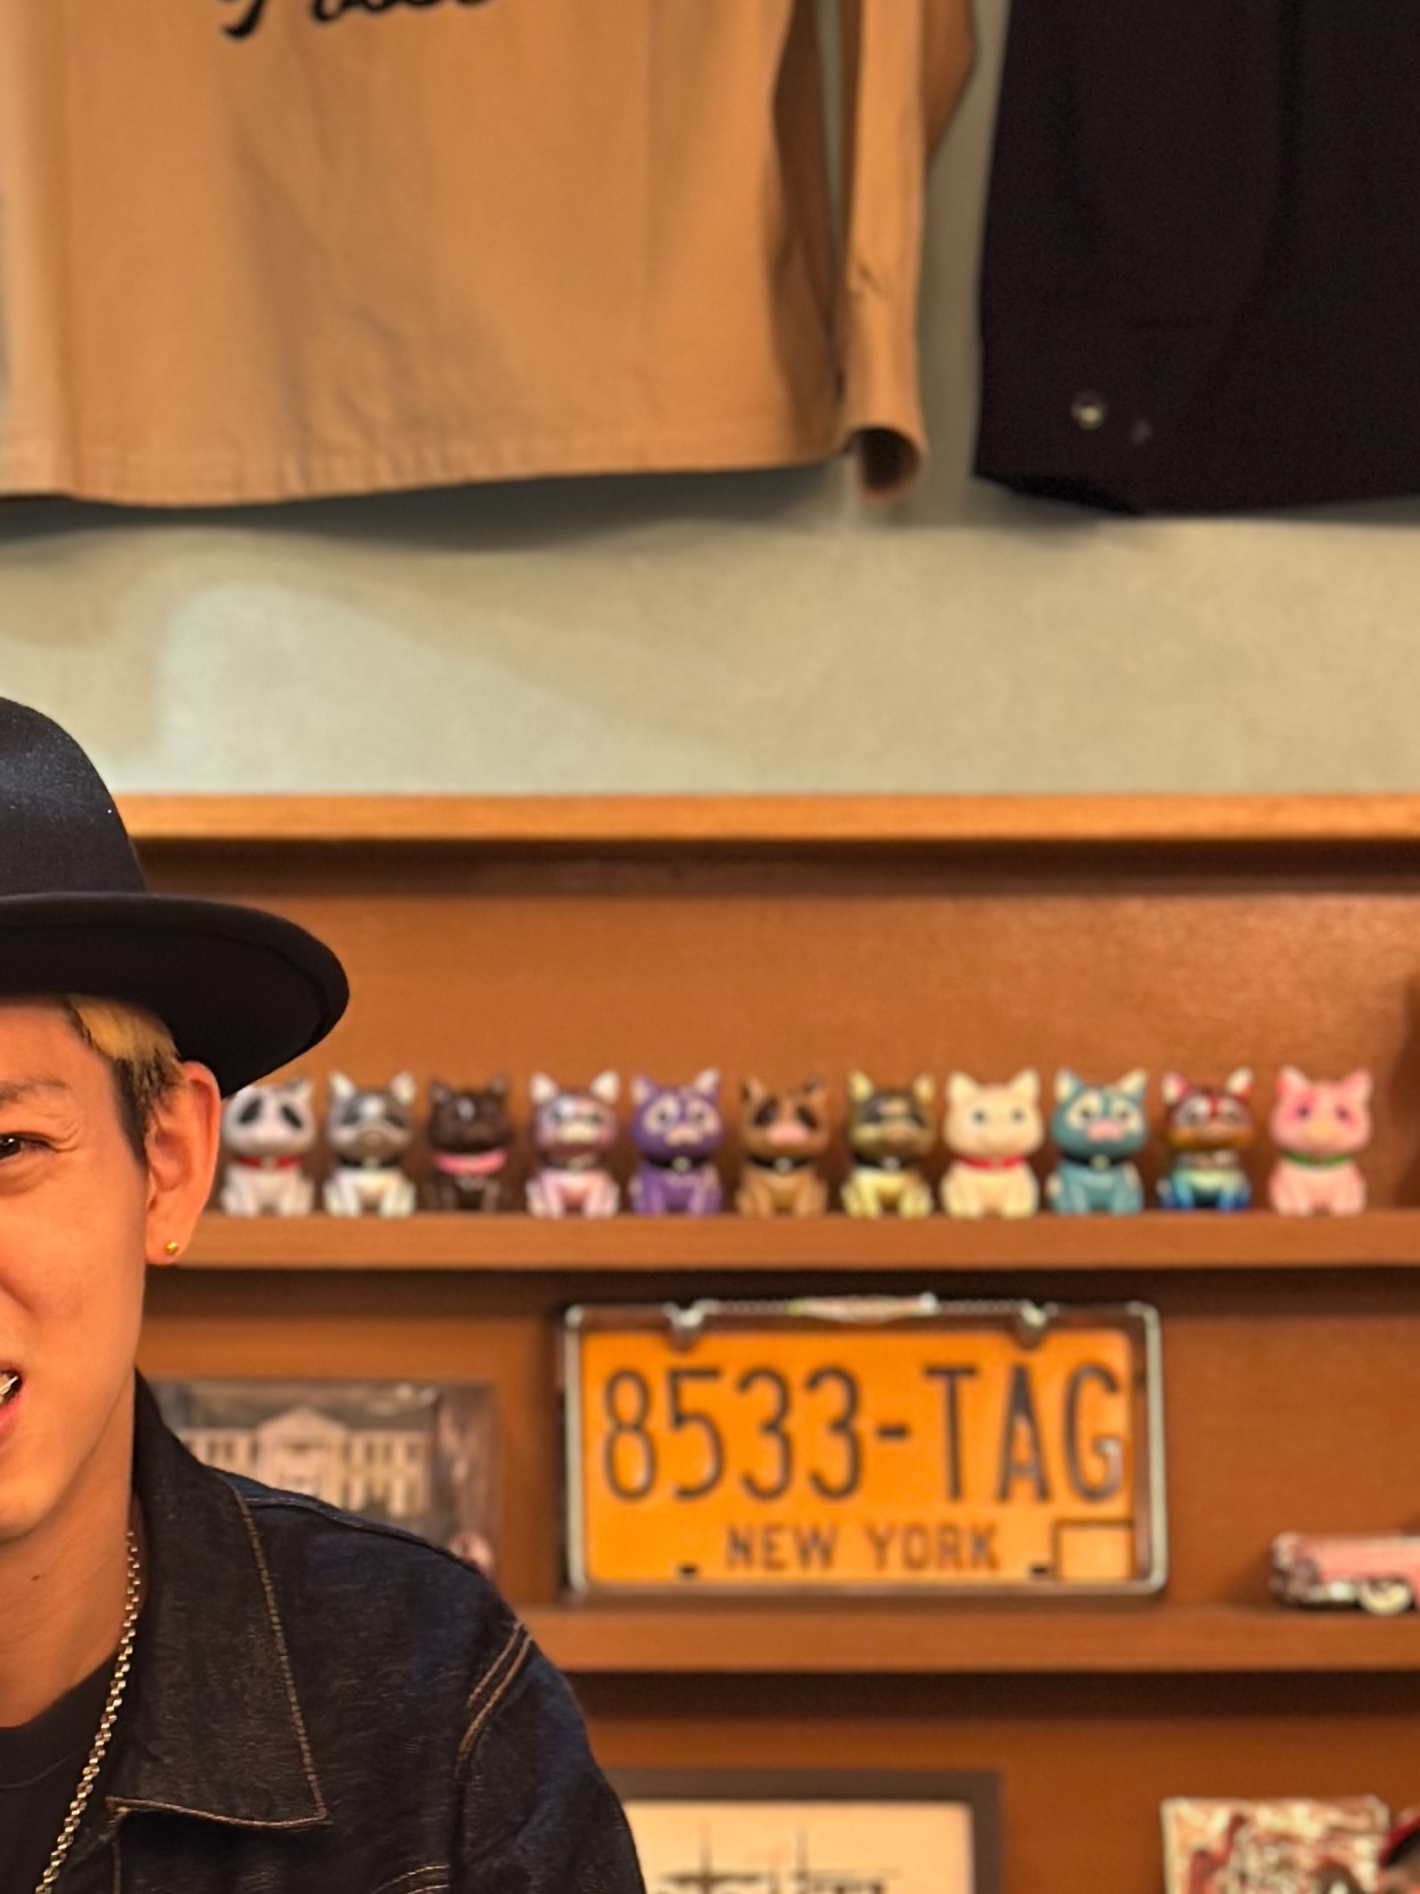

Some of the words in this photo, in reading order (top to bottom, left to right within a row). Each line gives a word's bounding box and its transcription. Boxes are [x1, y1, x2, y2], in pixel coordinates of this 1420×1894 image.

[602, 1362, 1126, 1504] 8533-TAG
[726, 1523, 841, 1571] NEW
[864, 1523, 1001, 1571] YORK
